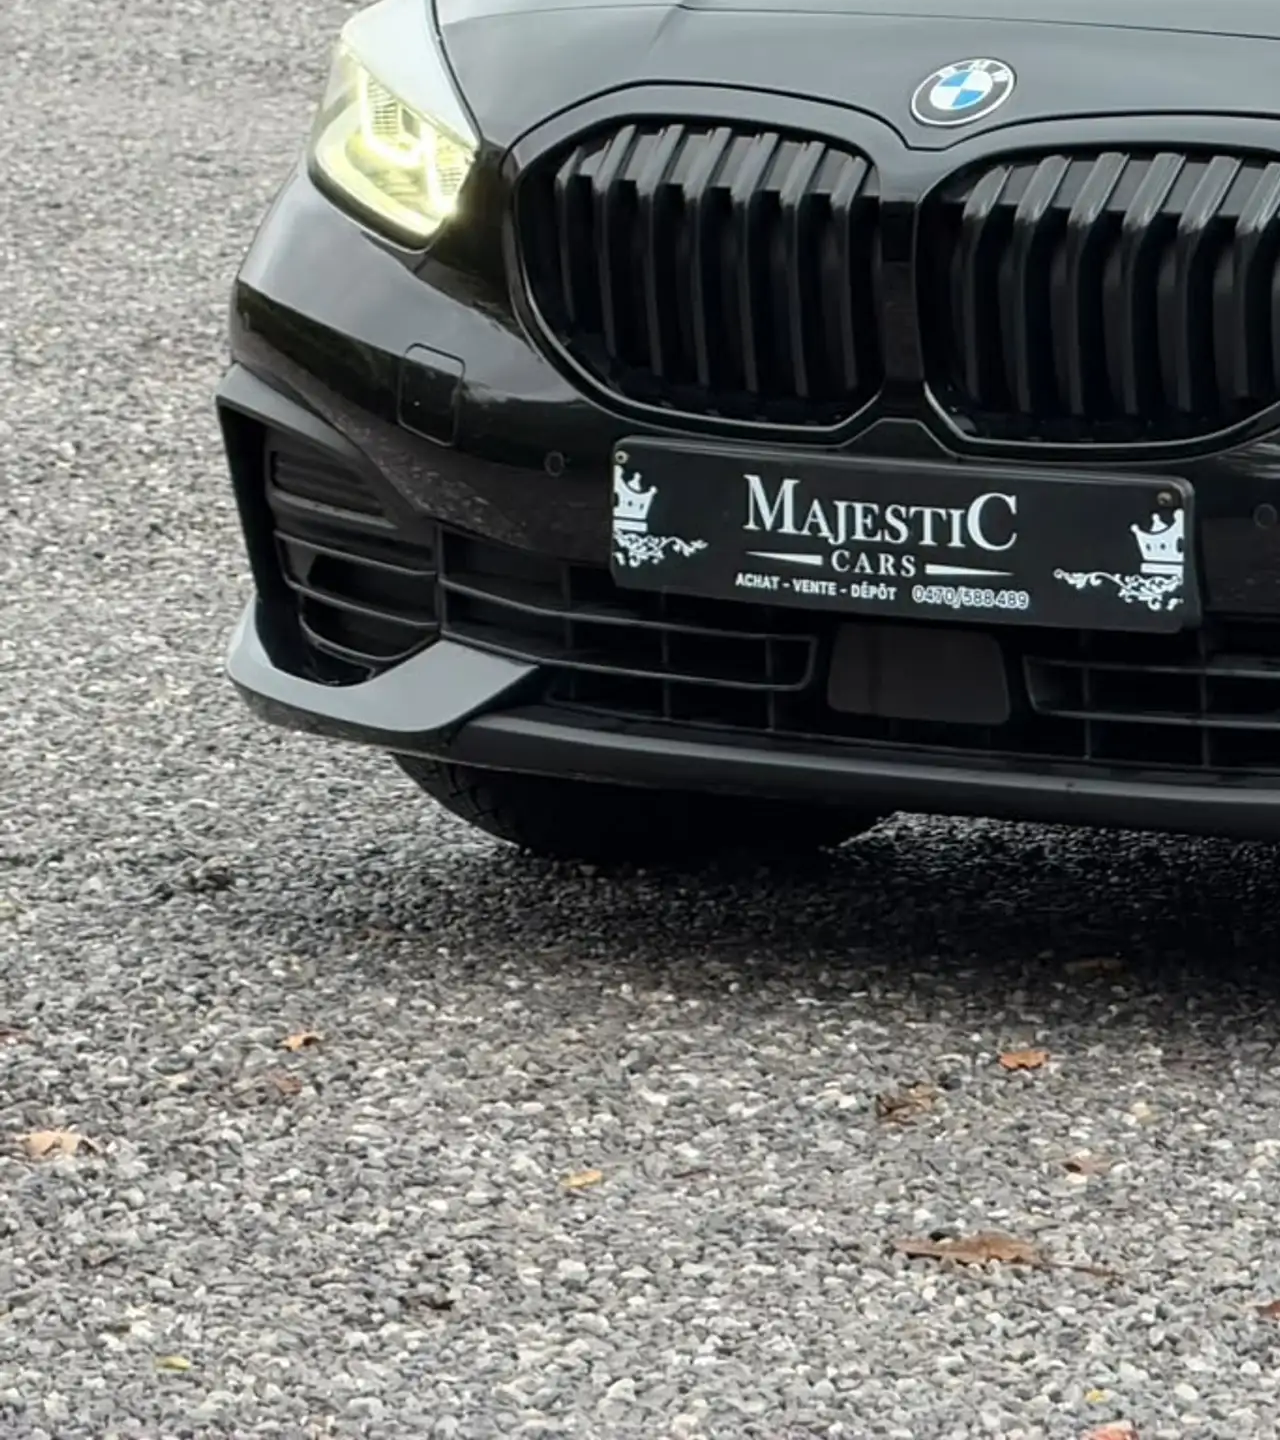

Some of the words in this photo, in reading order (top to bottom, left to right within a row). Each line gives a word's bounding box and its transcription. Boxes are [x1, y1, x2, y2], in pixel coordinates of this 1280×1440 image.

[743, 473, 1018, 552] MAJESTIC
[831, 549, 917, 578] CARS
[735, 573, 780, 591] ACHAT
[792, 579, 837, 596] VENTE
[850, 580, 898, 601] DÉPÔT
